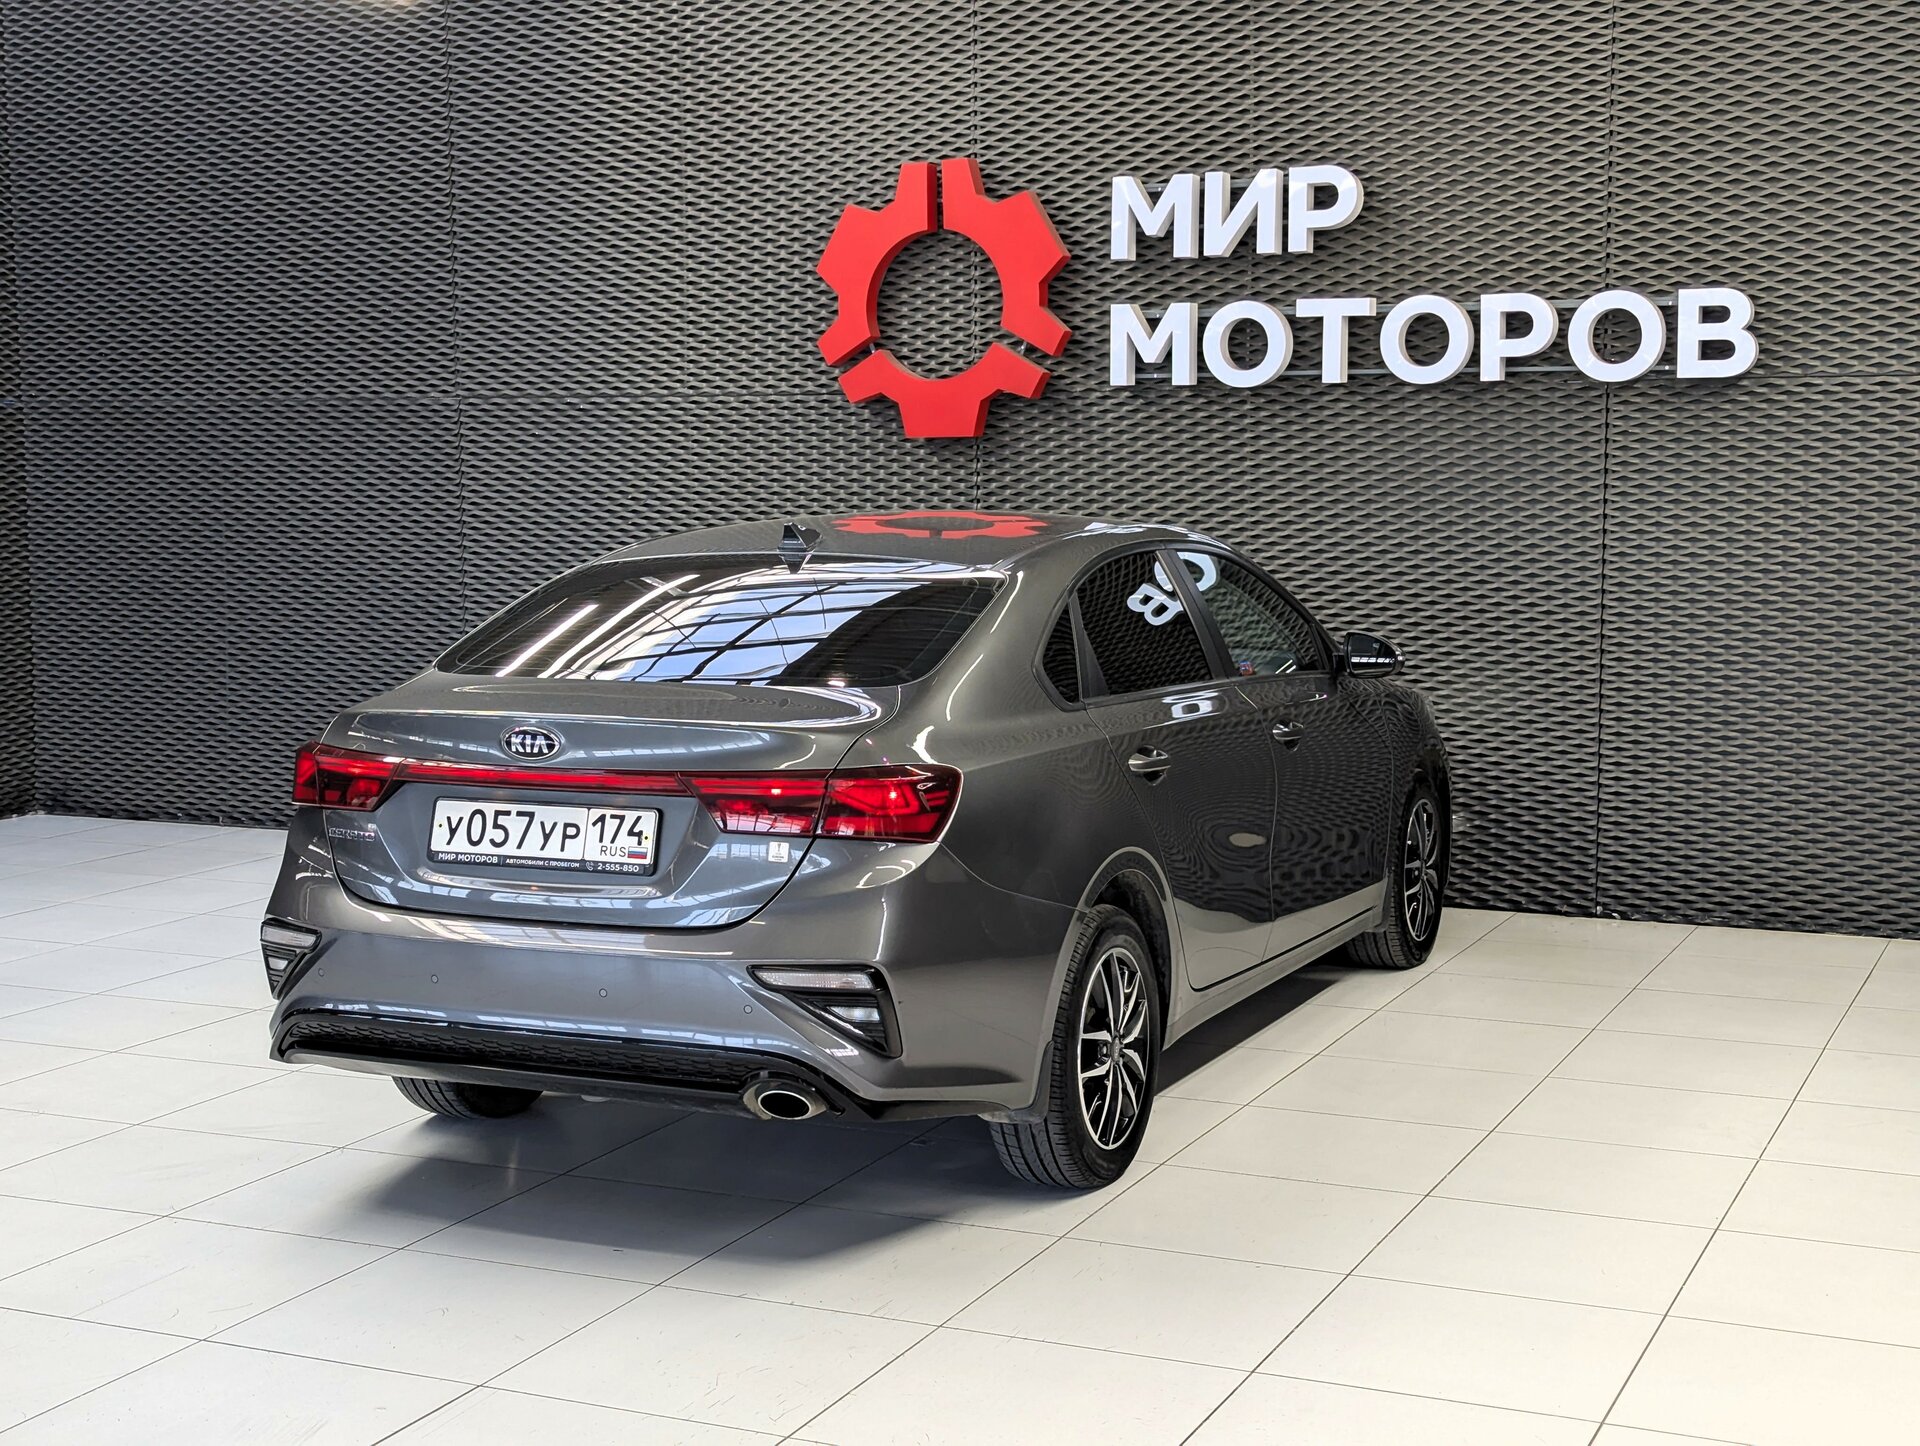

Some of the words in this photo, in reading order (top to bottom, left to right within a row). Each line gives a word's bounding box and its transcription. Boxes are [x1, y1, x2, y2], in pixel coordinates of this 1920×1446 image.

[1110, 164, 1364, 261] МИР
[1109, 285, 1760, 389] МОТОРОВ
[511, 733, 549, 754] KIA
[445, 808, 581, 853] У057УР
[591, 813, 644, 847] 174
[438, 852, 457, 861] МИР
[457, 853, 499, 864] МОТОРОВ
[600, 845, 626, 857] RUS
[505, 858, 544, 866] АВТОМОБИЛИ
[549, 860, 580, 868] ПРОБЕГОМ
[597, 862, 640, 873] 2-555-850
